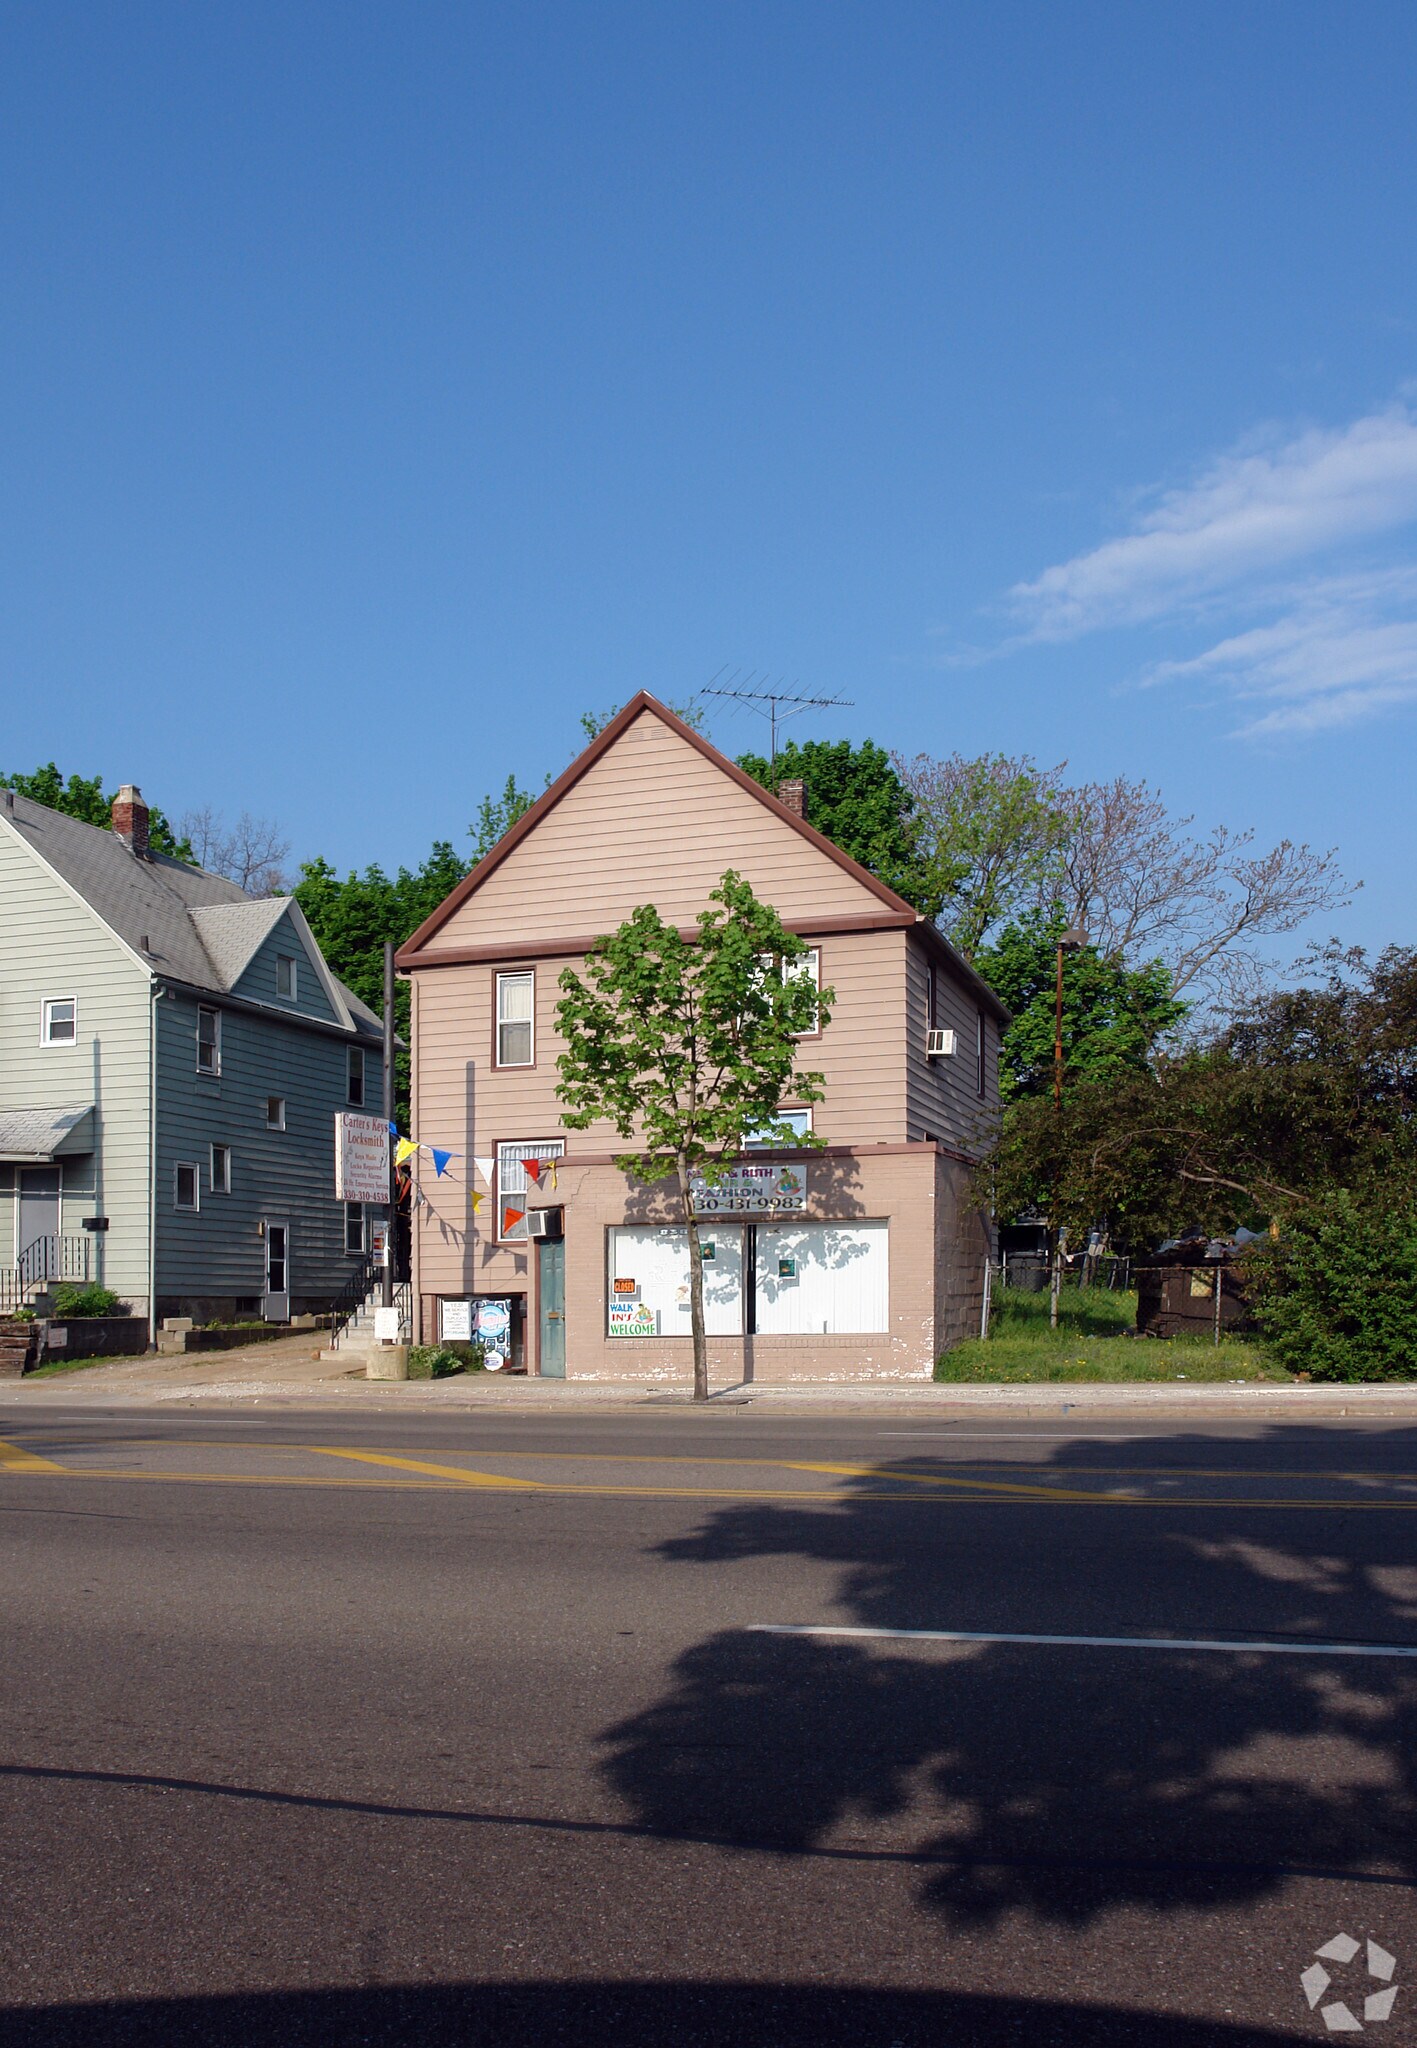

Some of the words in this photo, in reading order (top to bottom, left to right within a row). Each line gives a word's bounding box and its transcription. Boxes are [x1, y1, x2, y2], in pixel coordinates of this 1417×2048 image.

[343, 1113, 370, 1131] Carter's
[372, 1117, 389, 1135] Keys
[347, 1130, 385, 1148] Locksmith
[742, 1168, 773, 1178] RUTH
[694, 1197, 804, 1211] 30-431-9982
[610, 1303, 633, 1312] WALK
[611, 1313, 632, 1322] IN'S
[610, 1323, 656, 1335] WELCOME
